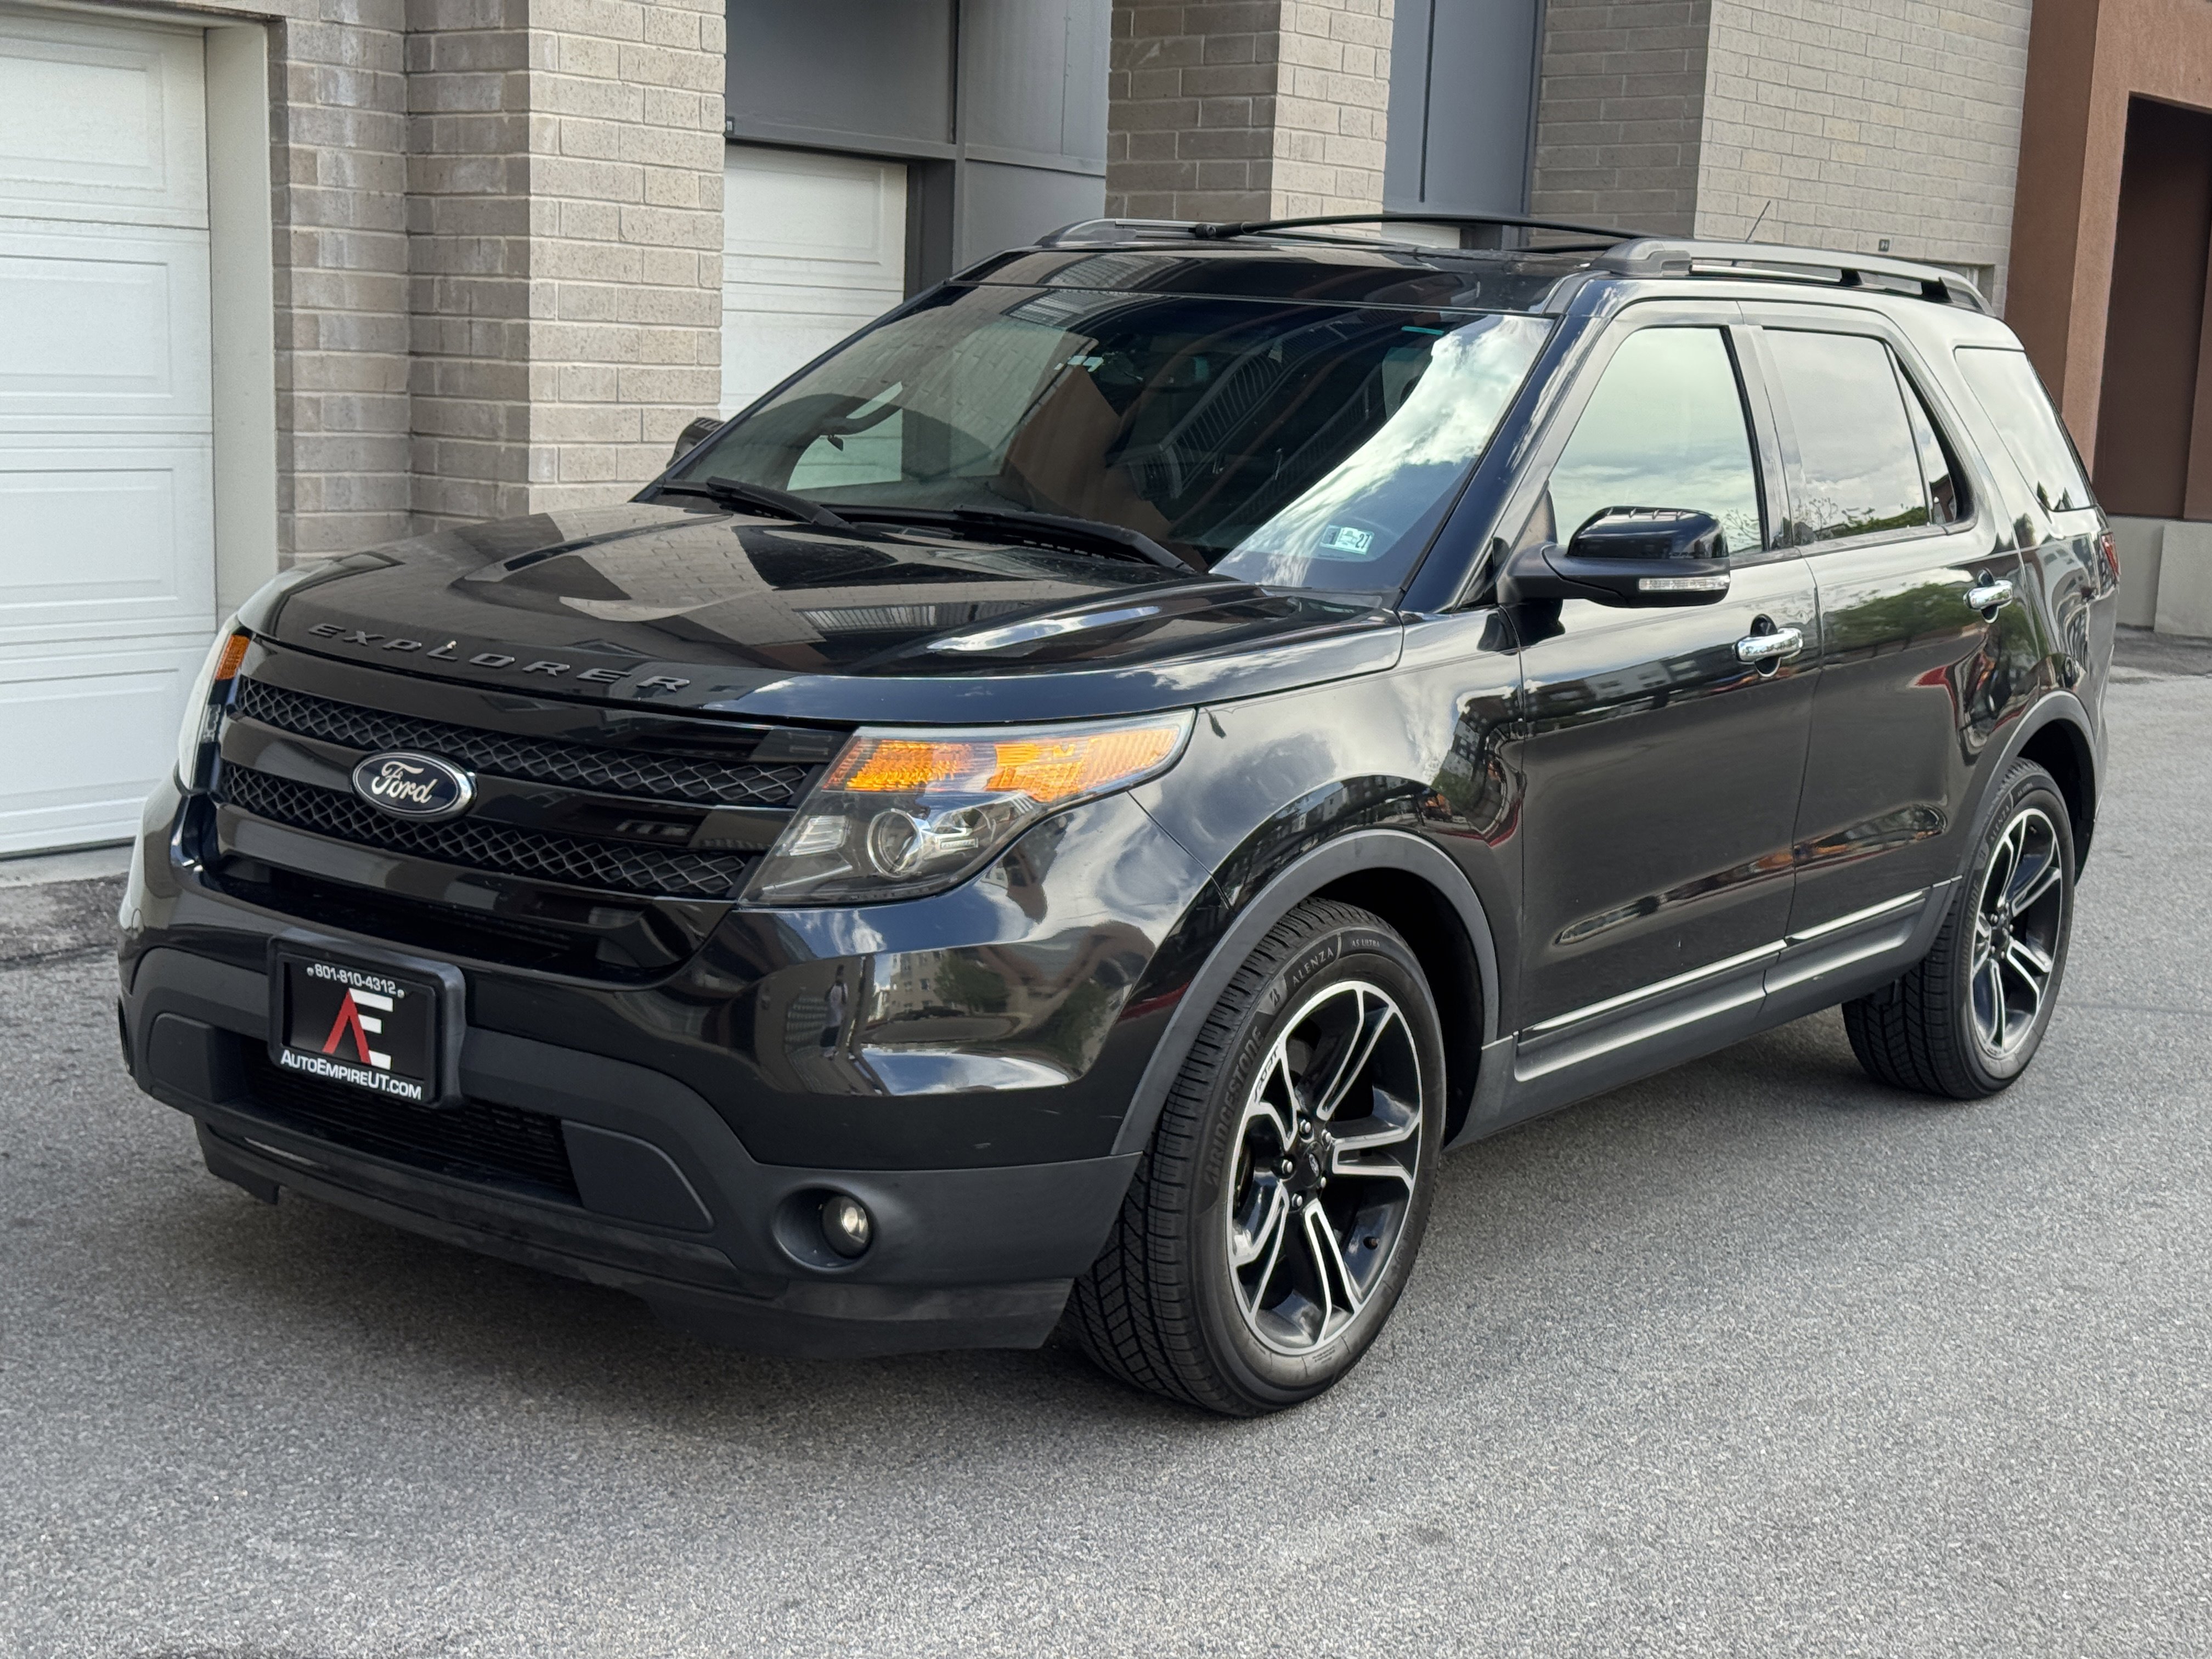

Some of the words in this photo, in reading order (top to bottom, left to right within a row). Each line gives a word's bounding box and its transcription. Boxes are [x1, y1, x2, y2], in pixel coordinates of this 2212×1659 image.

[1355, 533, 1370, 549] 27
[308, 623, 690, 692] EXPLORER
[372, 761, 438, 803] Ford
[314, 964, 396, 995] 801-810-4312
[1293, 947, 1334, 987] ALENZA
[1207, 1025, 1263, 1186] BRIDGESTONE
